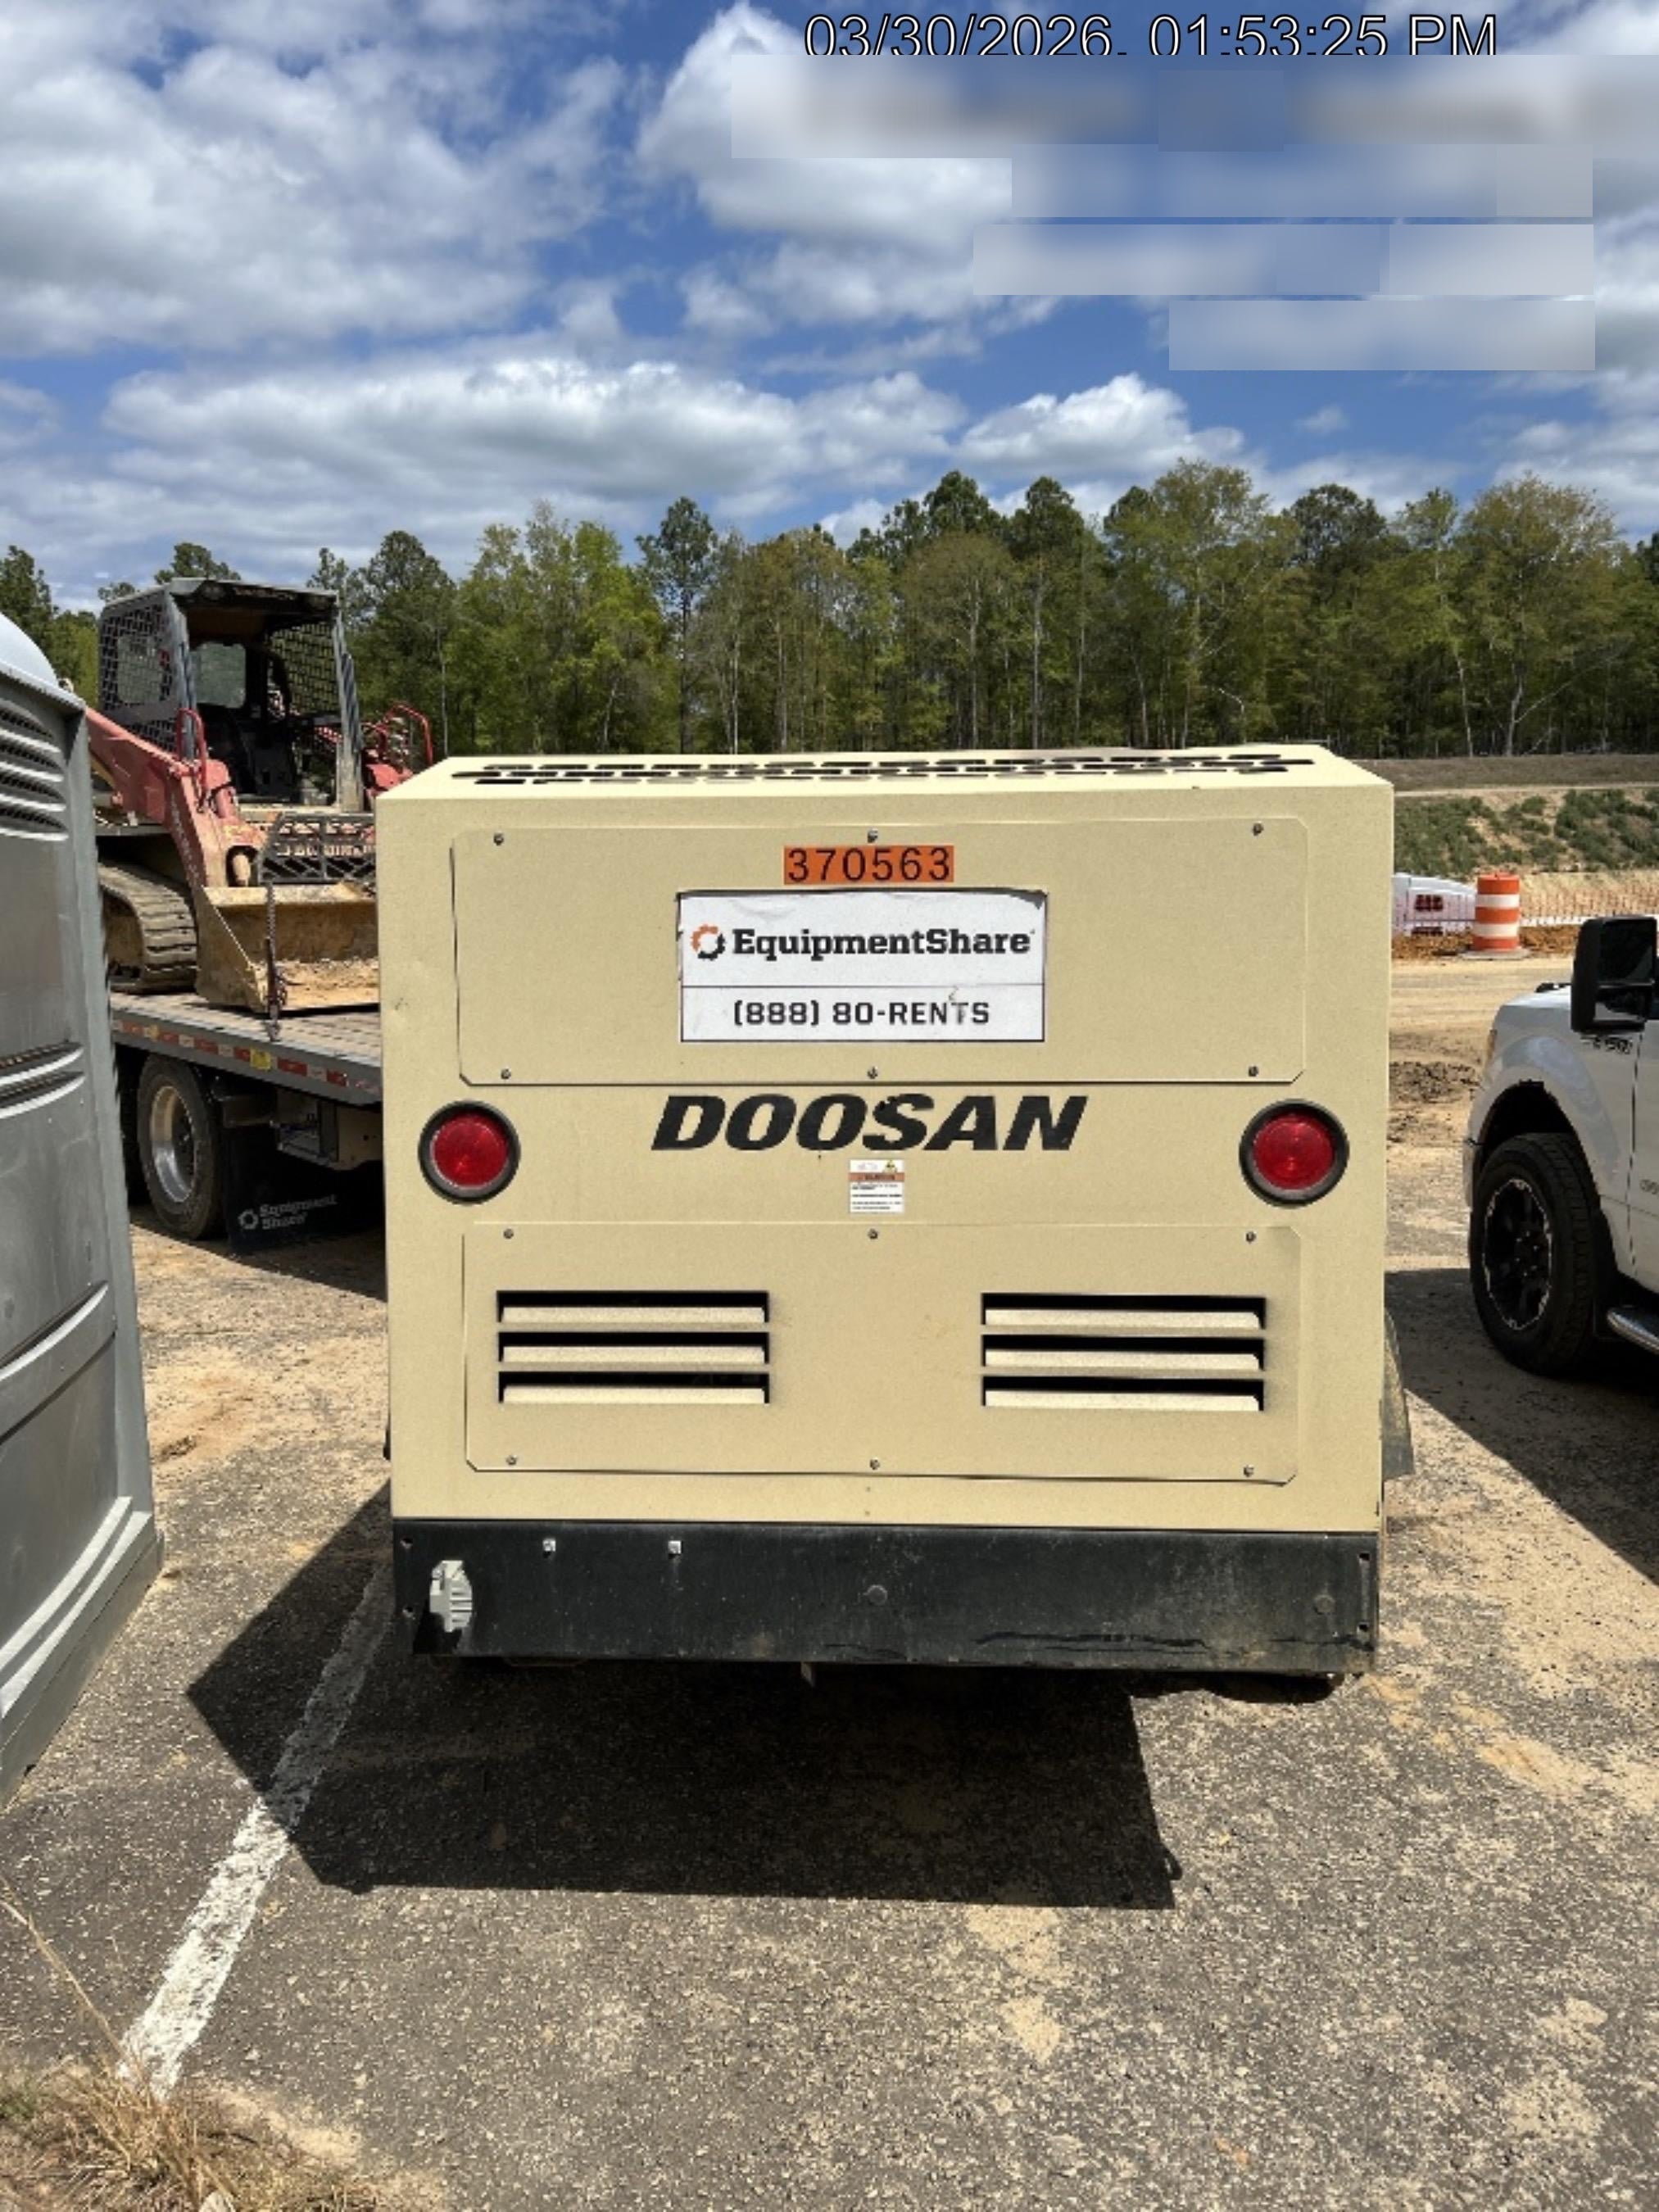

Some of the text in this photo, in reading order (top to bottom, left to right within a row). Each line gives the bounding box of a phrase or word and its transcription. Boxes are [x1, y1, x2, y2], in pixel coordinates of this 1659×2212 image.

[787, 847, 950, 882] 370563
[732, 928, 1031, 962] EquipmentShare
[734, 999, 990, 1026] (888) 80-RENTS
[651, 1094, 1088, 1151] DOOSAN
